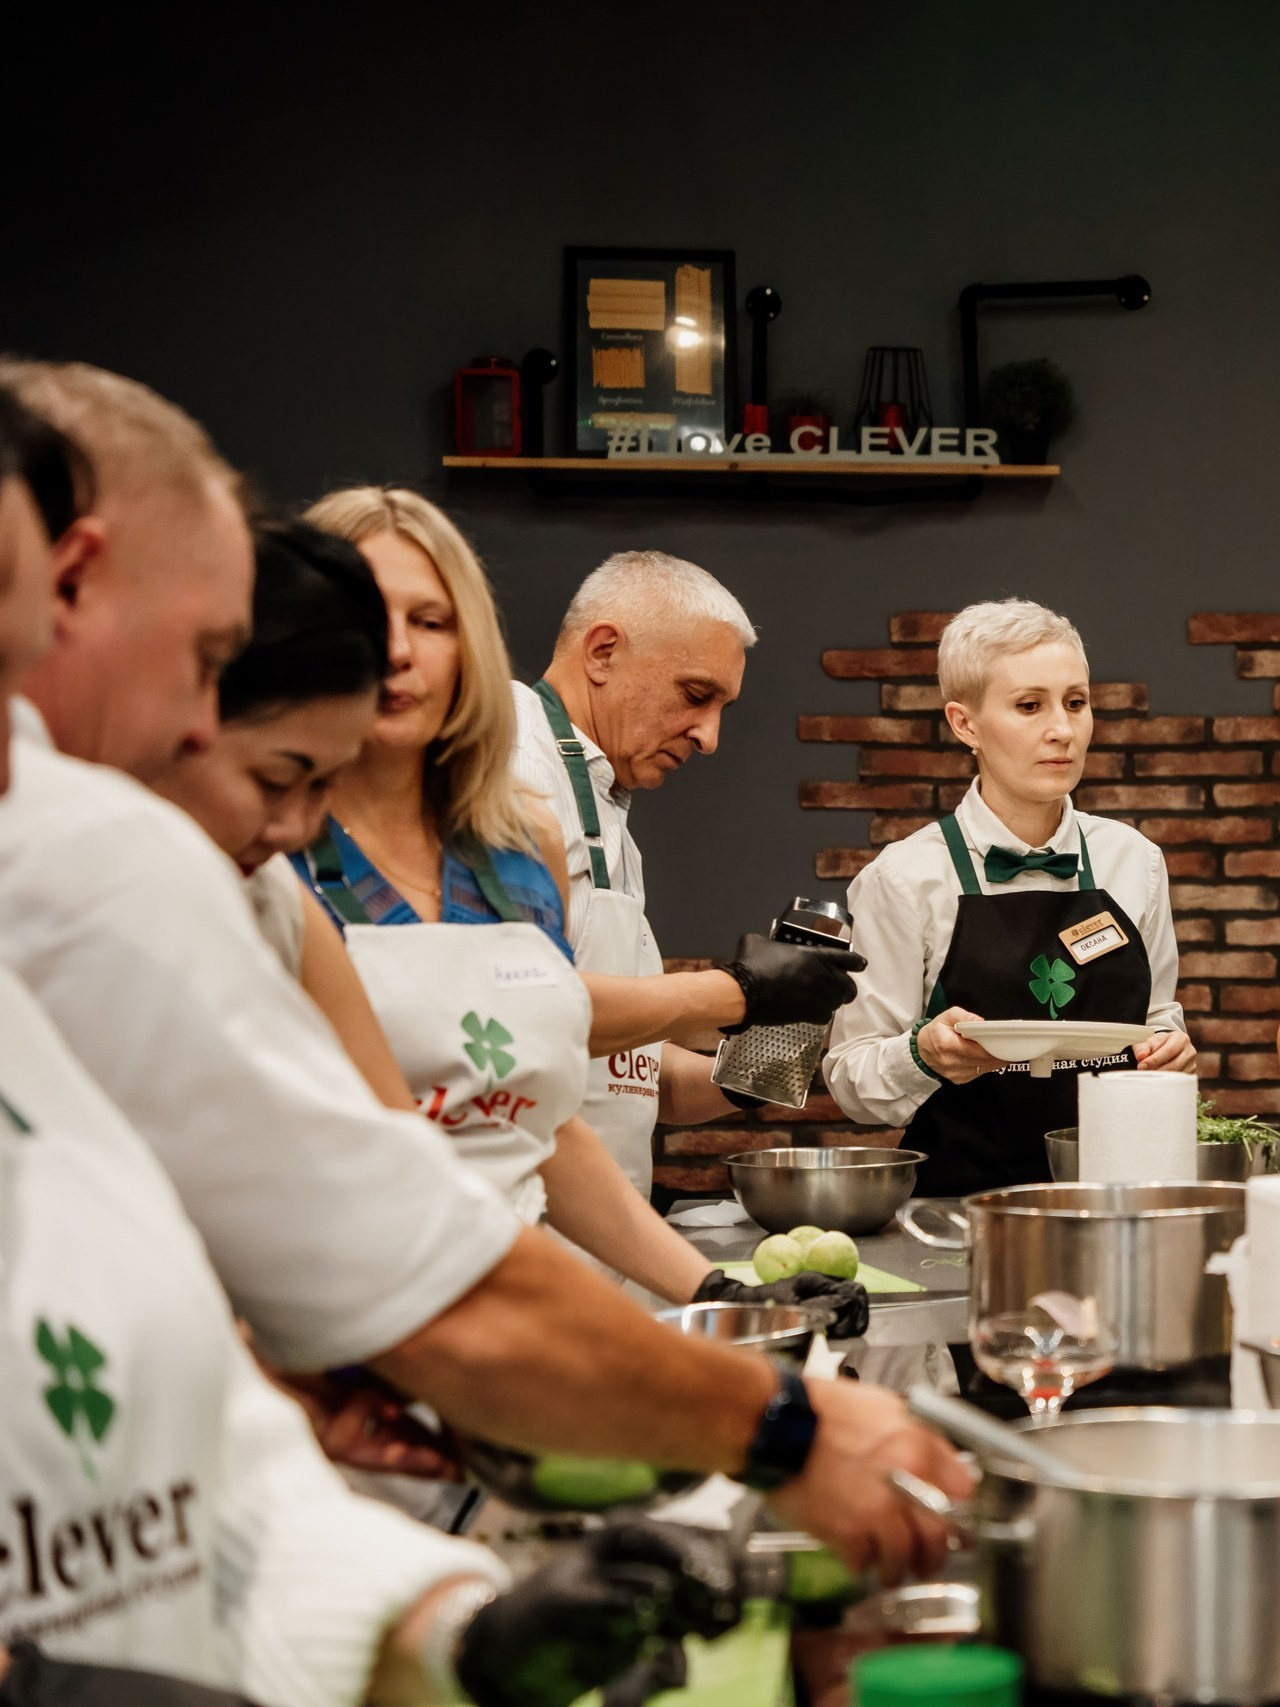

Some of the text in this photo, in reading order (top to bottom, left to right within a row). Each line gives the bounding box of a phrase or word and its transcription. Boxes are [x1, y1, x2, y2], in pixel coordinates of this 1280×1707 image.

[789, 424, 1000, 462] CLEVER
[1078, 918, 1103, 934] clever
[1080, 935, 1108, 952] ОКСАНА
[1081, 1053, 1129, 1069] студия
[0, 1481, 196, 1601] lever
